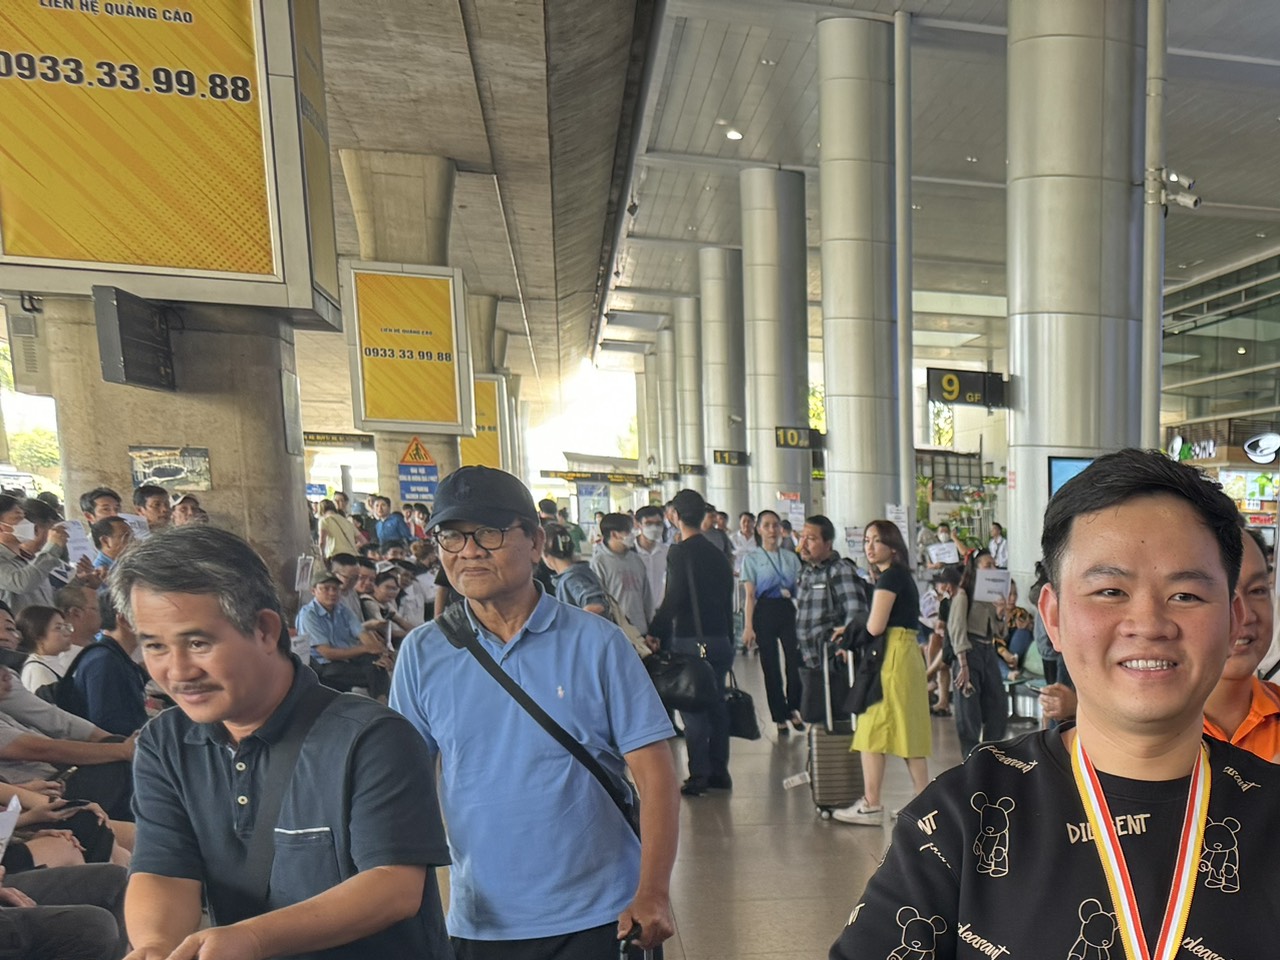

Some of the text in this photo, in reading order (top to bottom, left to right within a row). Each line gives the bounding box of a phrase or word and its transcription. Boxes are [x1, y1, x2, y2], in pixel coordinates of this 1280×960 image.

[105, 1, 157, 19] QUẢNG
[163, 8, 193, 24] CÁO
[0, 50, 252, 102] 0933.33.99.88
[364, 347, 452, 362] 0933.33.99.88
[941, 373, 982, 403] 9 GF
[777, 429, 799, 446] 10
[714, 451, 729, 464] 11
